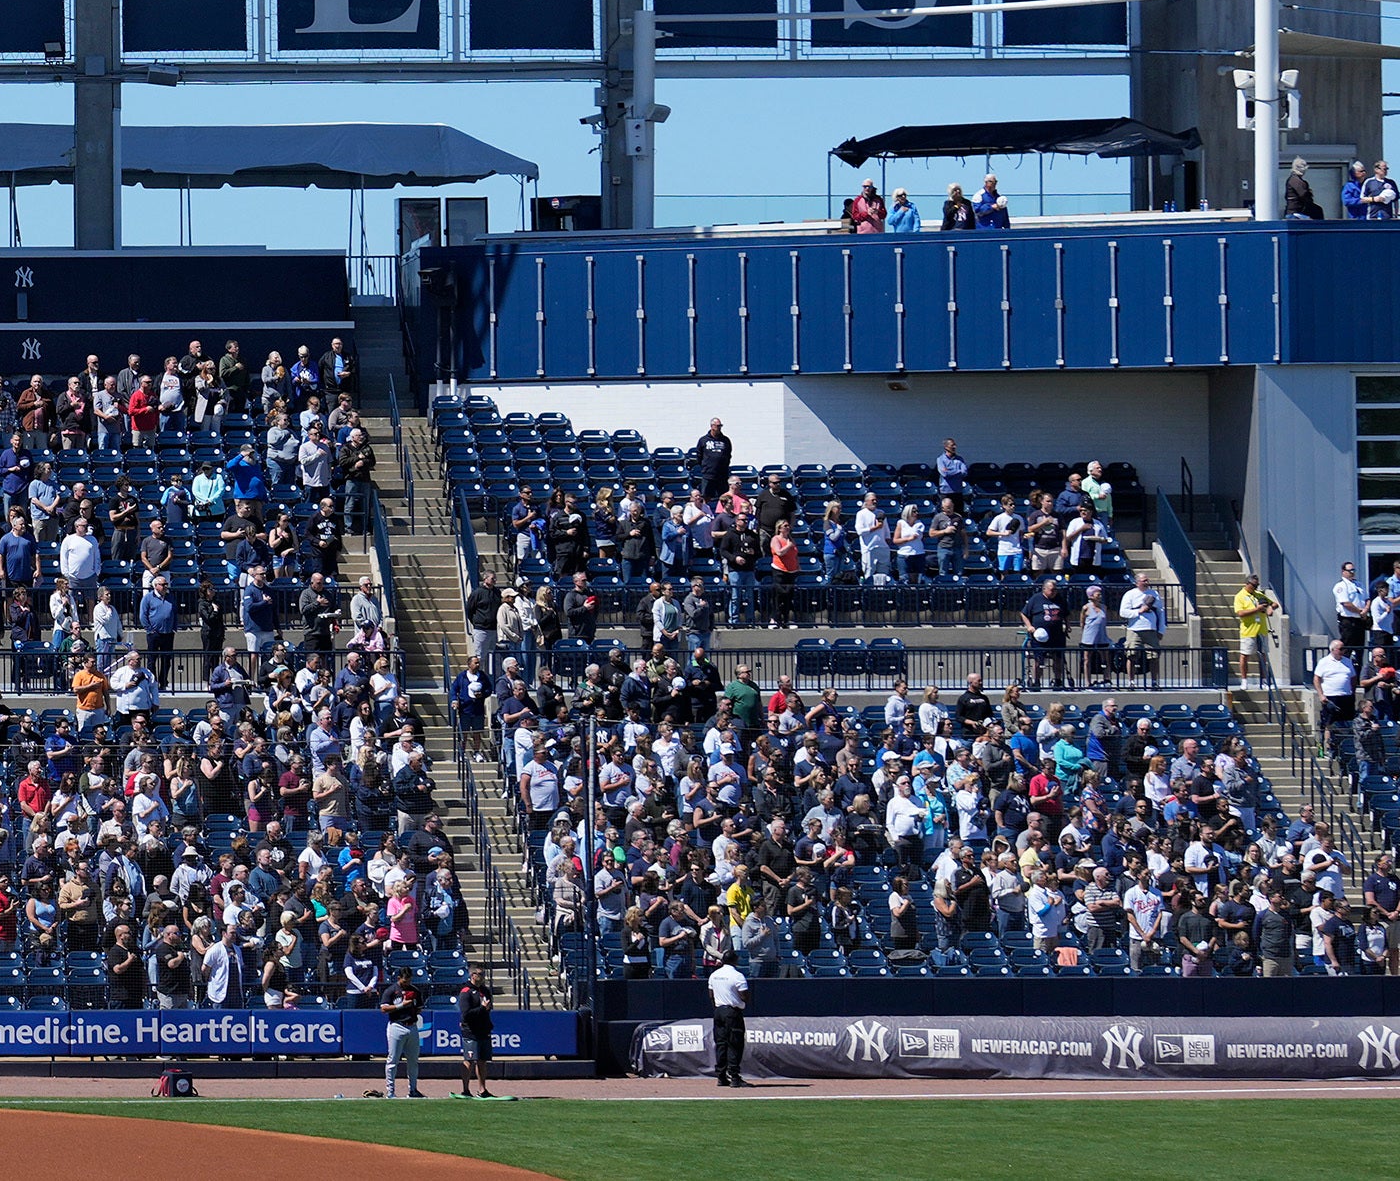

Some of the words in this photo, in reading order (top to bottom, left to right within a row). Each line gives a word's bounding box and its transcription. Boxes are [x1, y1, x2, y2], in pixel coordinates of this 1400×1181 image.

[14, 265, 35, 288] NY
[21, 337, 42, 360] NY
[136, 1015, 269, 1044] Heartfelt
[274, 1021, 344, 1044] care.
[676, 1029, 699, 1037] NEW
[746, 1029, 837, 1047] ERACAP.COM
[932, 1034, 955, 1043] NEW
[436, 1029, 521, 1049] Baare
[677, 1037, 699, 1045] ERA
[845, 1019, 890, 1063] NY
[932, 1043, 955, 1052] ERA
[971, 1038, 1092, 1057] NEWERACAP.COM
[1101, 1024, 1146, 1070] NY
[1188, 1041, 1210, 1050] NEW
[1356, 1024, 1400, 1070] NY
[1188, 1049, 1210, 1059] ERA
[1226, 1043, 1348, 1059] NEWERACAP.COM
